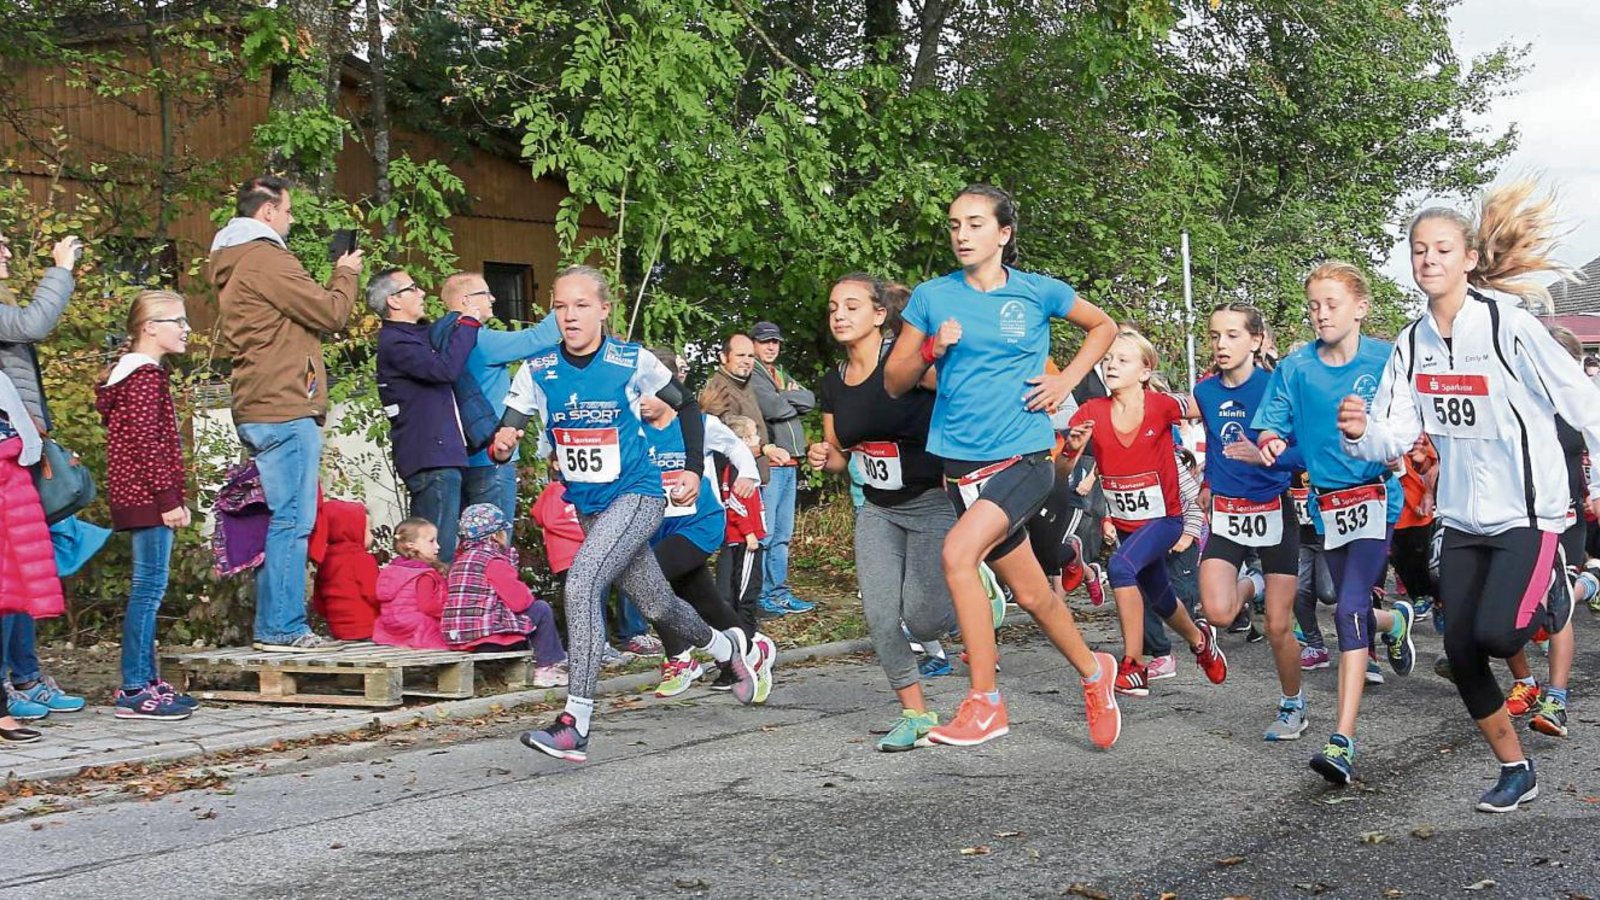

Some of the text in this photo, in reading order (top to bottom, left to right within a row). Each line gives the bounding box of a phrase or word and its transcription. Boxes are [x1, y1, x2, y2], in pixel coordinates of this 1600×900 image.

[1441, 384, 1473, 392] Sparkasse
[569, 408, 621, 421] SPORT
[1218, 409, 1246, 418] skinfit
[1433, 397, 1476, 427] 589
[566, 448, 603, 473] 565
[1114, 490, 1150, 512] 554
[1227, 514, 1268, 538] 540
[1335, 503, 1368, 535] 533
